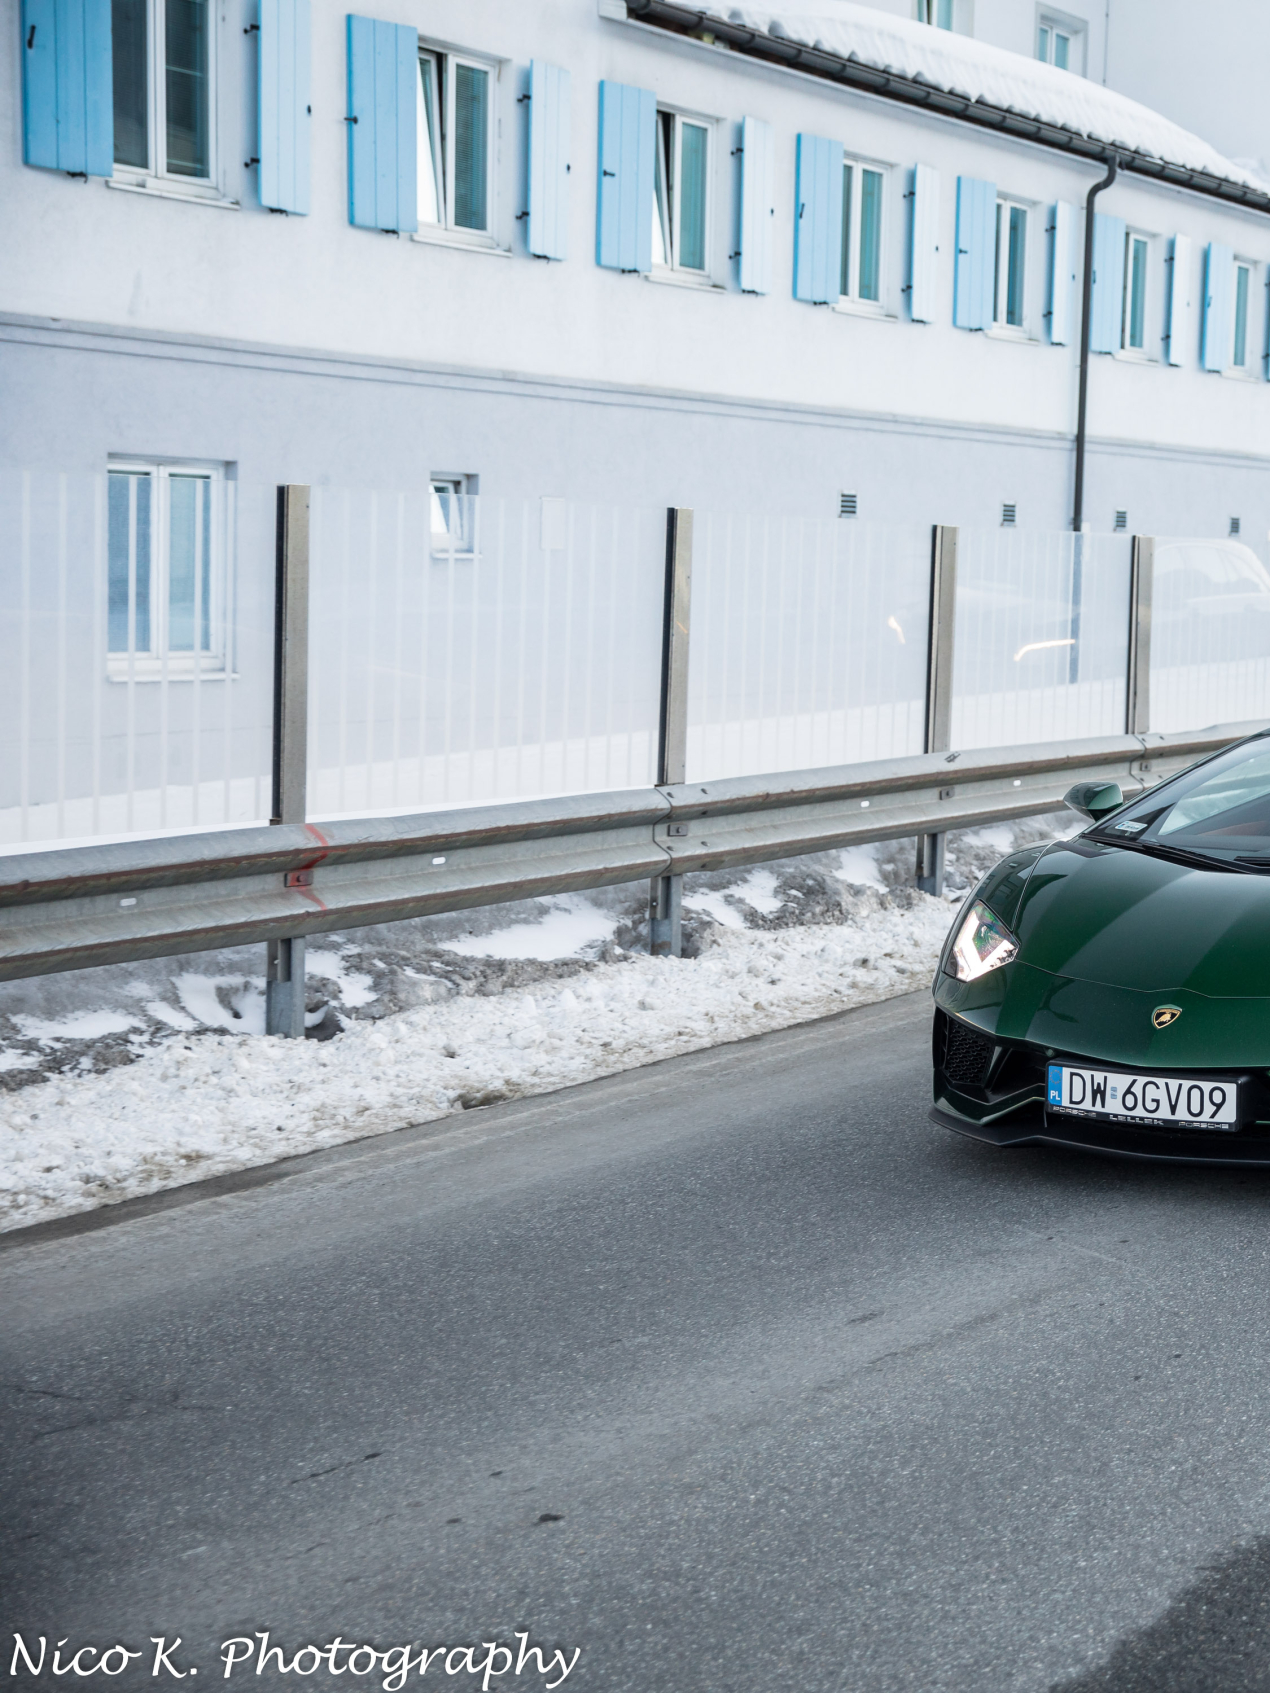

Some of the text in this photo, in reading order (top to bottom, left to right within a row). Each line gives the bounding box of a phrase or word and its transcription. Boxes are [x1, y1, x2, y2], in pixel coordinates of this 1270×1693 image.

[1050, 1090, 1061, 1101] PL
[1069, 1071, 1227, 1120] DW 6GV09
